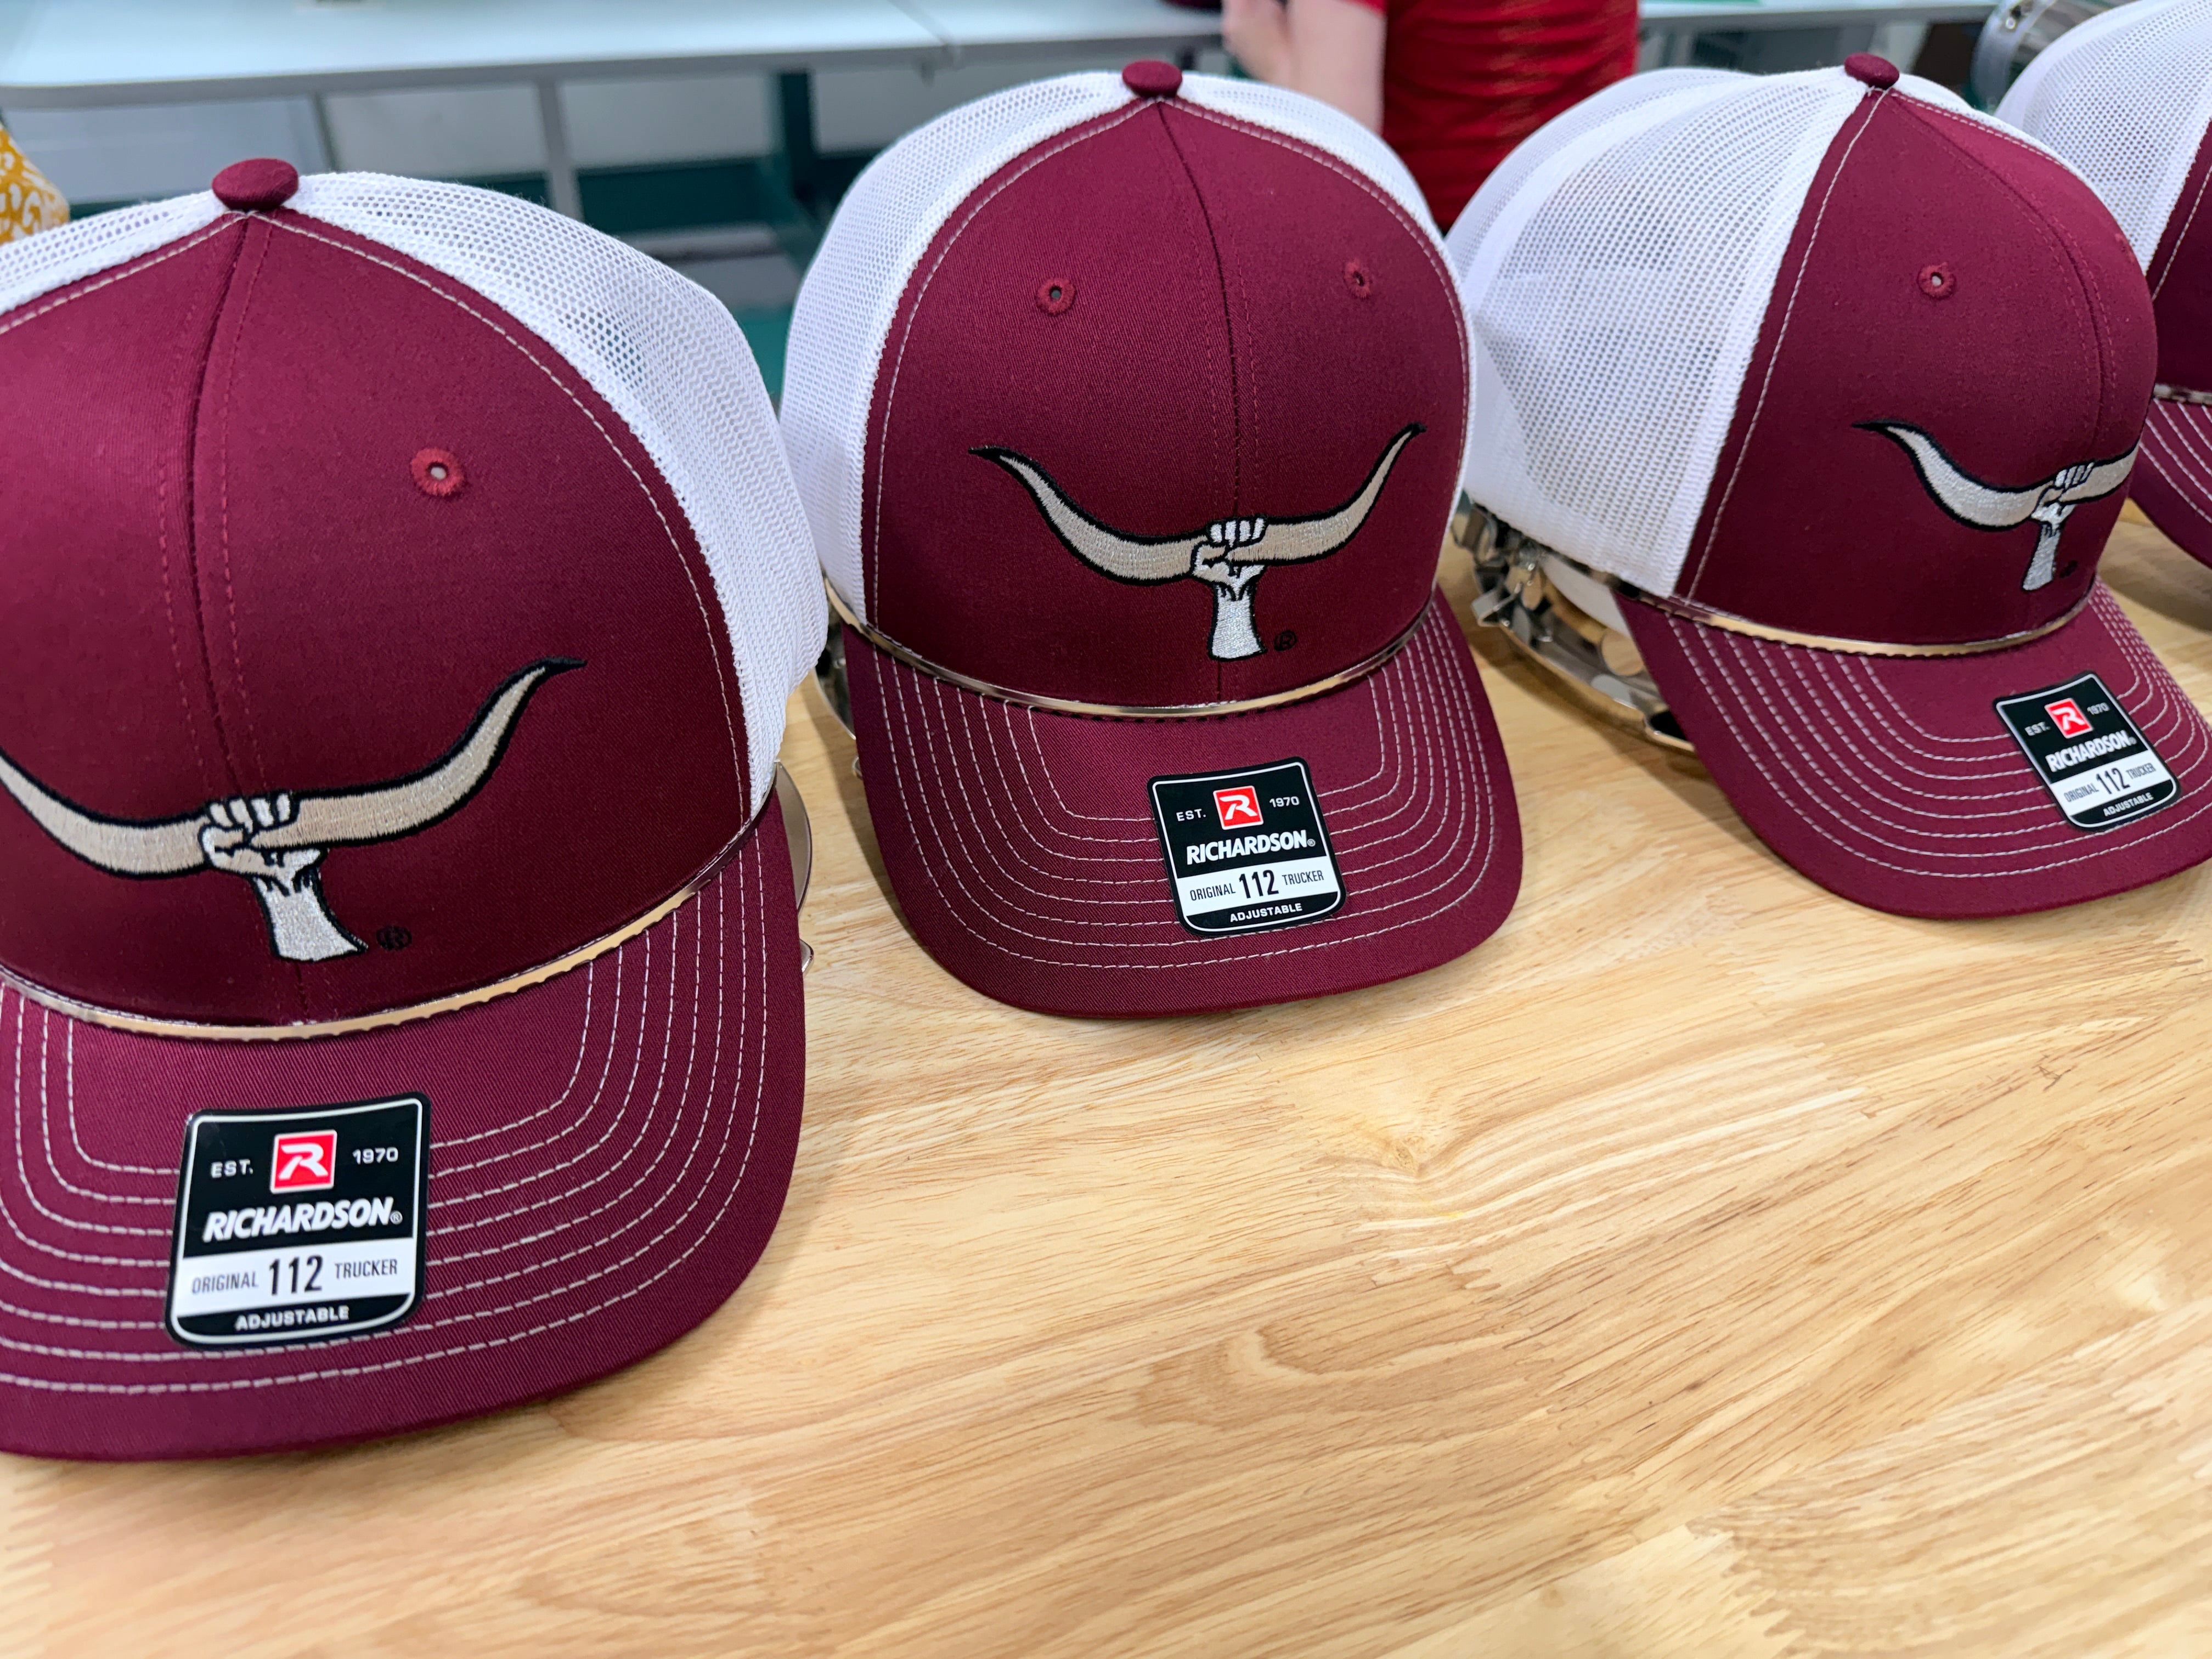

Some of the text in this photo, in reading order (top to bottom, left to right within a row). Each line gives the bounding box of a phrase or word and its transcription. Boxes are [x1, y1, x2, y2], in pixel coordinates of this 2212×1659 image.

[2025, 702, 2109, 736] EST. 1970
[2063, 763, 2156, 803] ORIGINAL 112 TRUCKER
[1176, 796, 1300, 822] EST. 1970
[1219, 794, 1257, 820] R
[2104, 792, 2154, 816] ADJUSTABLE
[1190, 870, 1324, 901] ORIGINAL 112 TRUCKER
[1230, 903, 1302, 922] ADJUSTABLE
[211, 1147, 399, 1178] EST. 1970
[278, 1143, 329, 1180] R
[192, 1255, 398, 1295] ORIGINAL 112 TRUCKER
[234, 1306, 349, 1331] ADJUSTABLE
